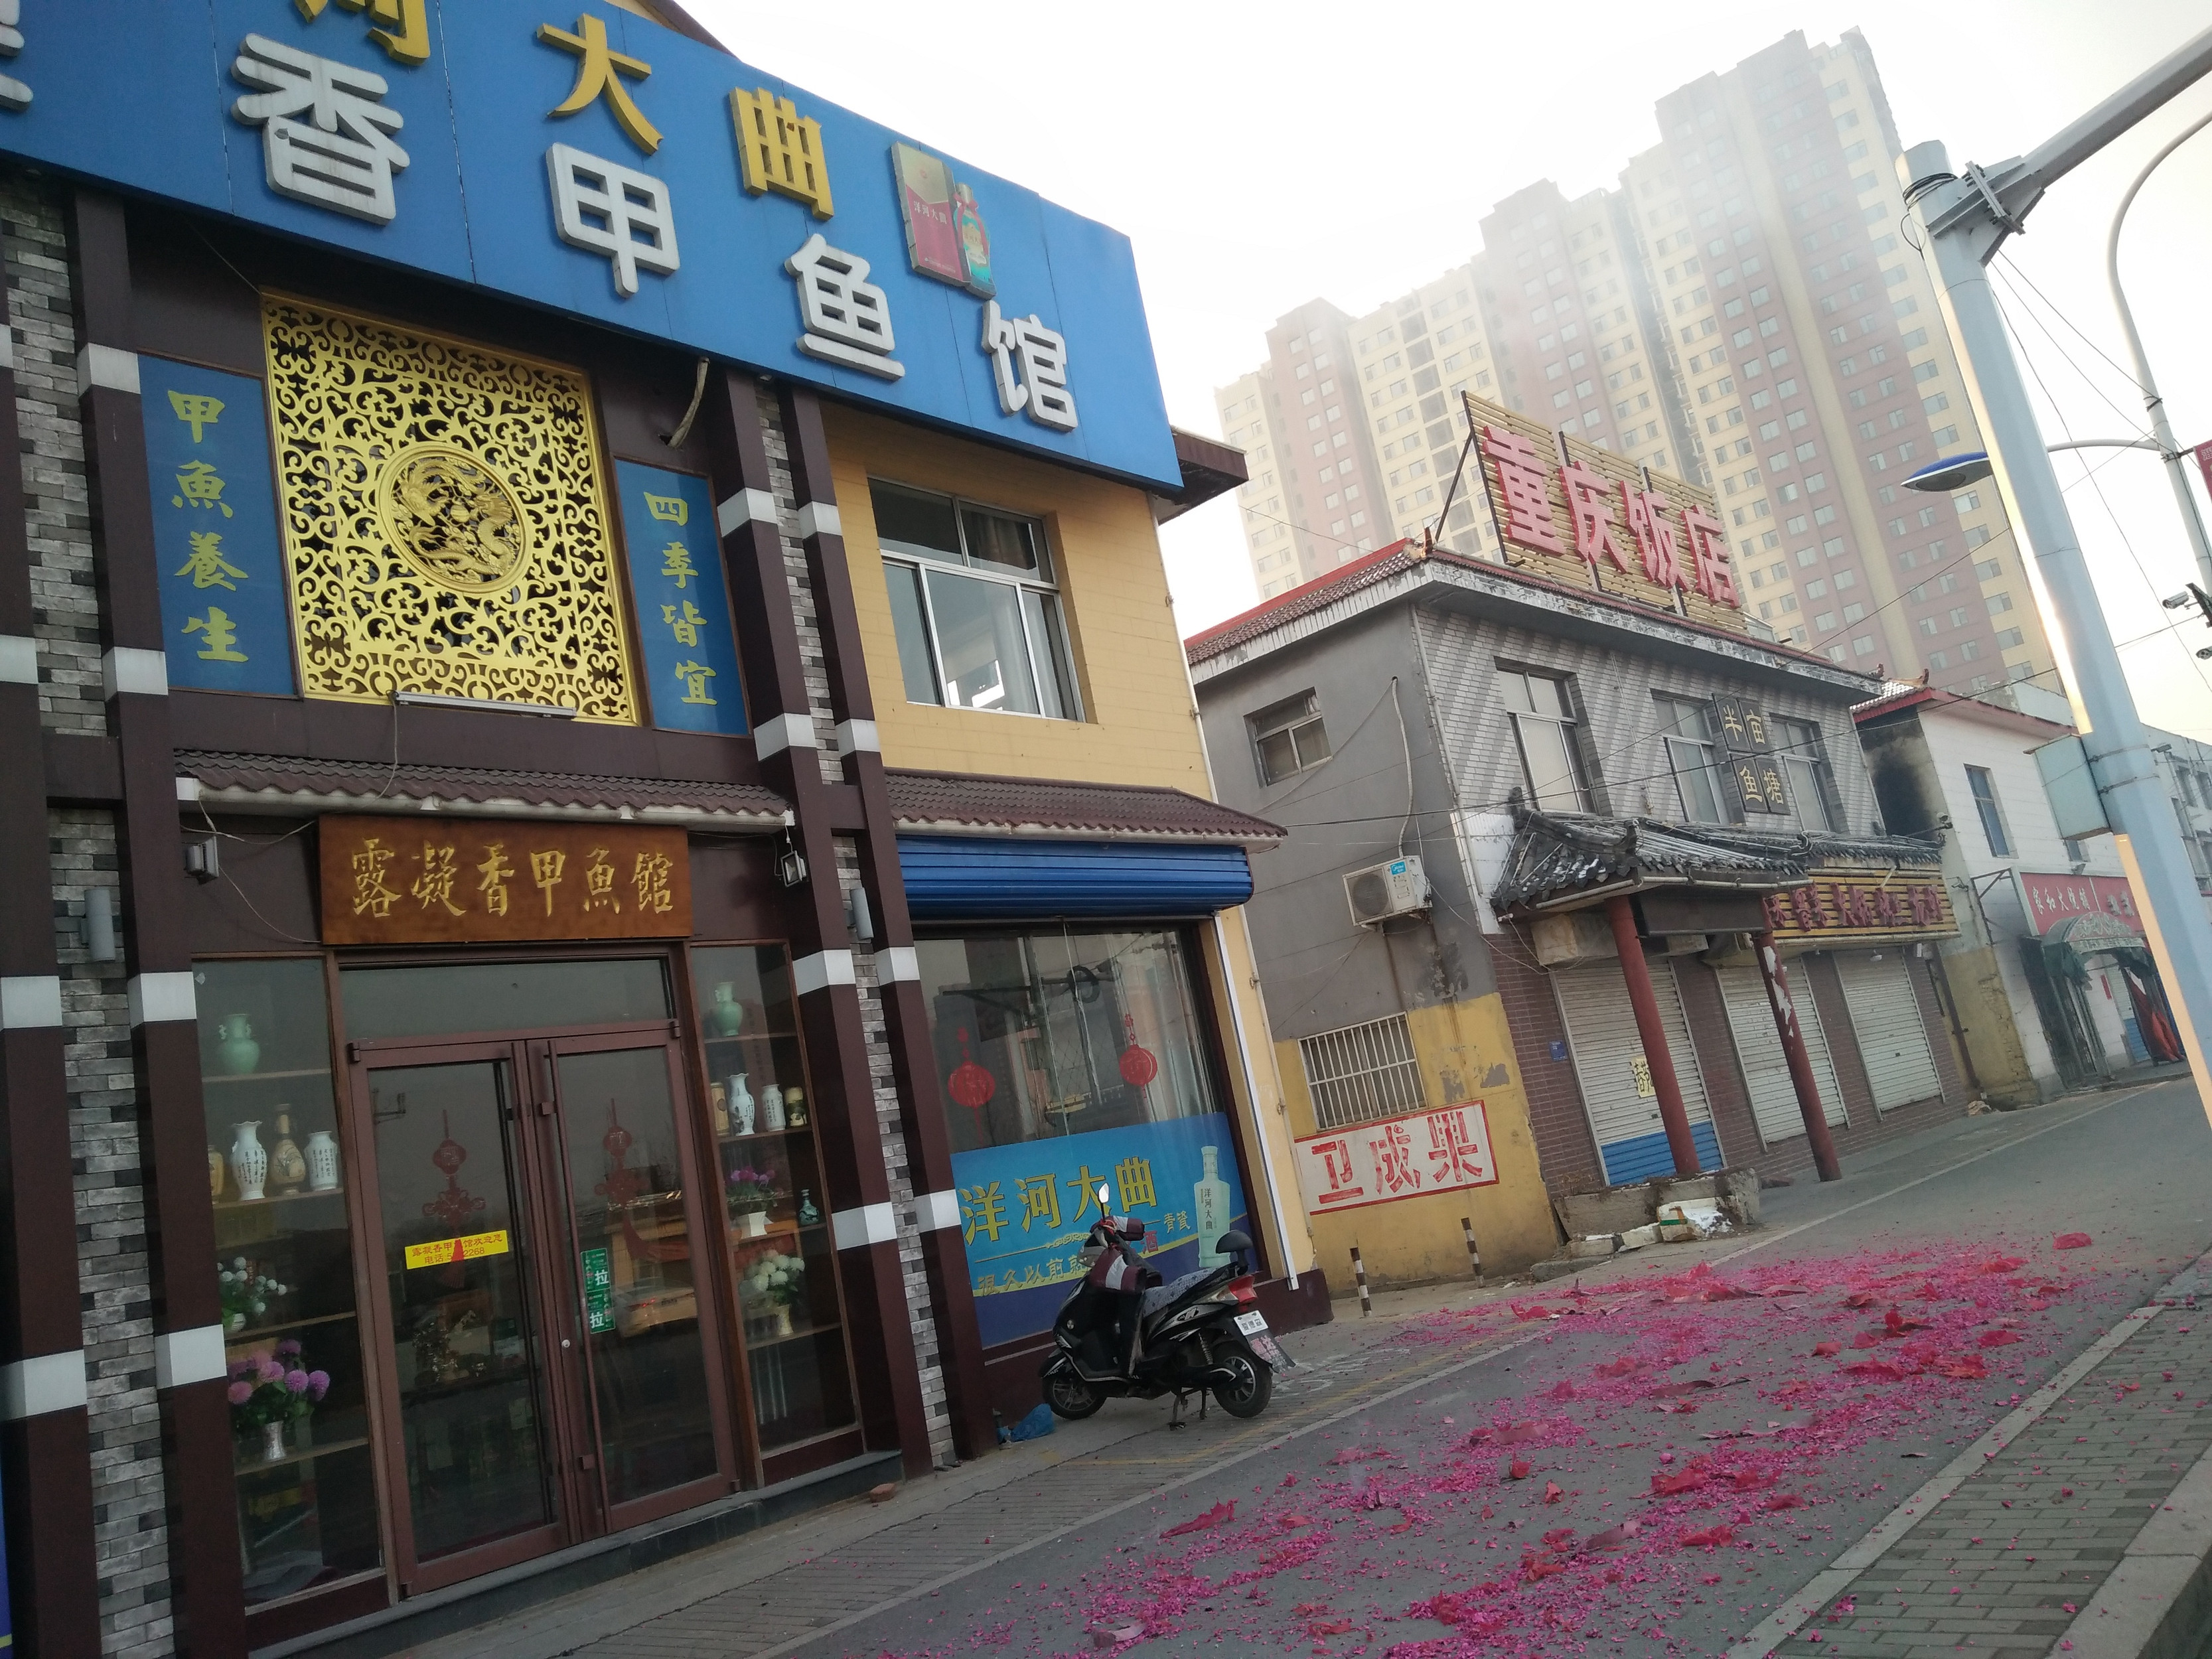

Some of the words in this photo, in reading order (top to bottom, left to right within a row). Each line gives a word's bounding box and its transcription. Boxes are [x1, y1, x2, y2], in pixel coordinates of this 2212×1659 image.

[0, 0, 1078, 433] 香甲鱼馆
[167, 390, 249, 662] 甲魚養生
[1482, 425, 1739, 609] 重庆饭店
[643, 491, 717, 705] 四季皆宜
[959, 1156, 1158, 1246] 洋河大曲
[1204, 1188, 1214, 1230] 洋河大曲
[1163, 1212, 1192, 1234] 青瓷
[411, 1234, 503, 1257] 露凝香甲馆欢迎您
[425, 1254, 444, 1264] 电话
[595, 1269, 610, 1286] 拉
[589, 1312, 605, 1329] 拉
